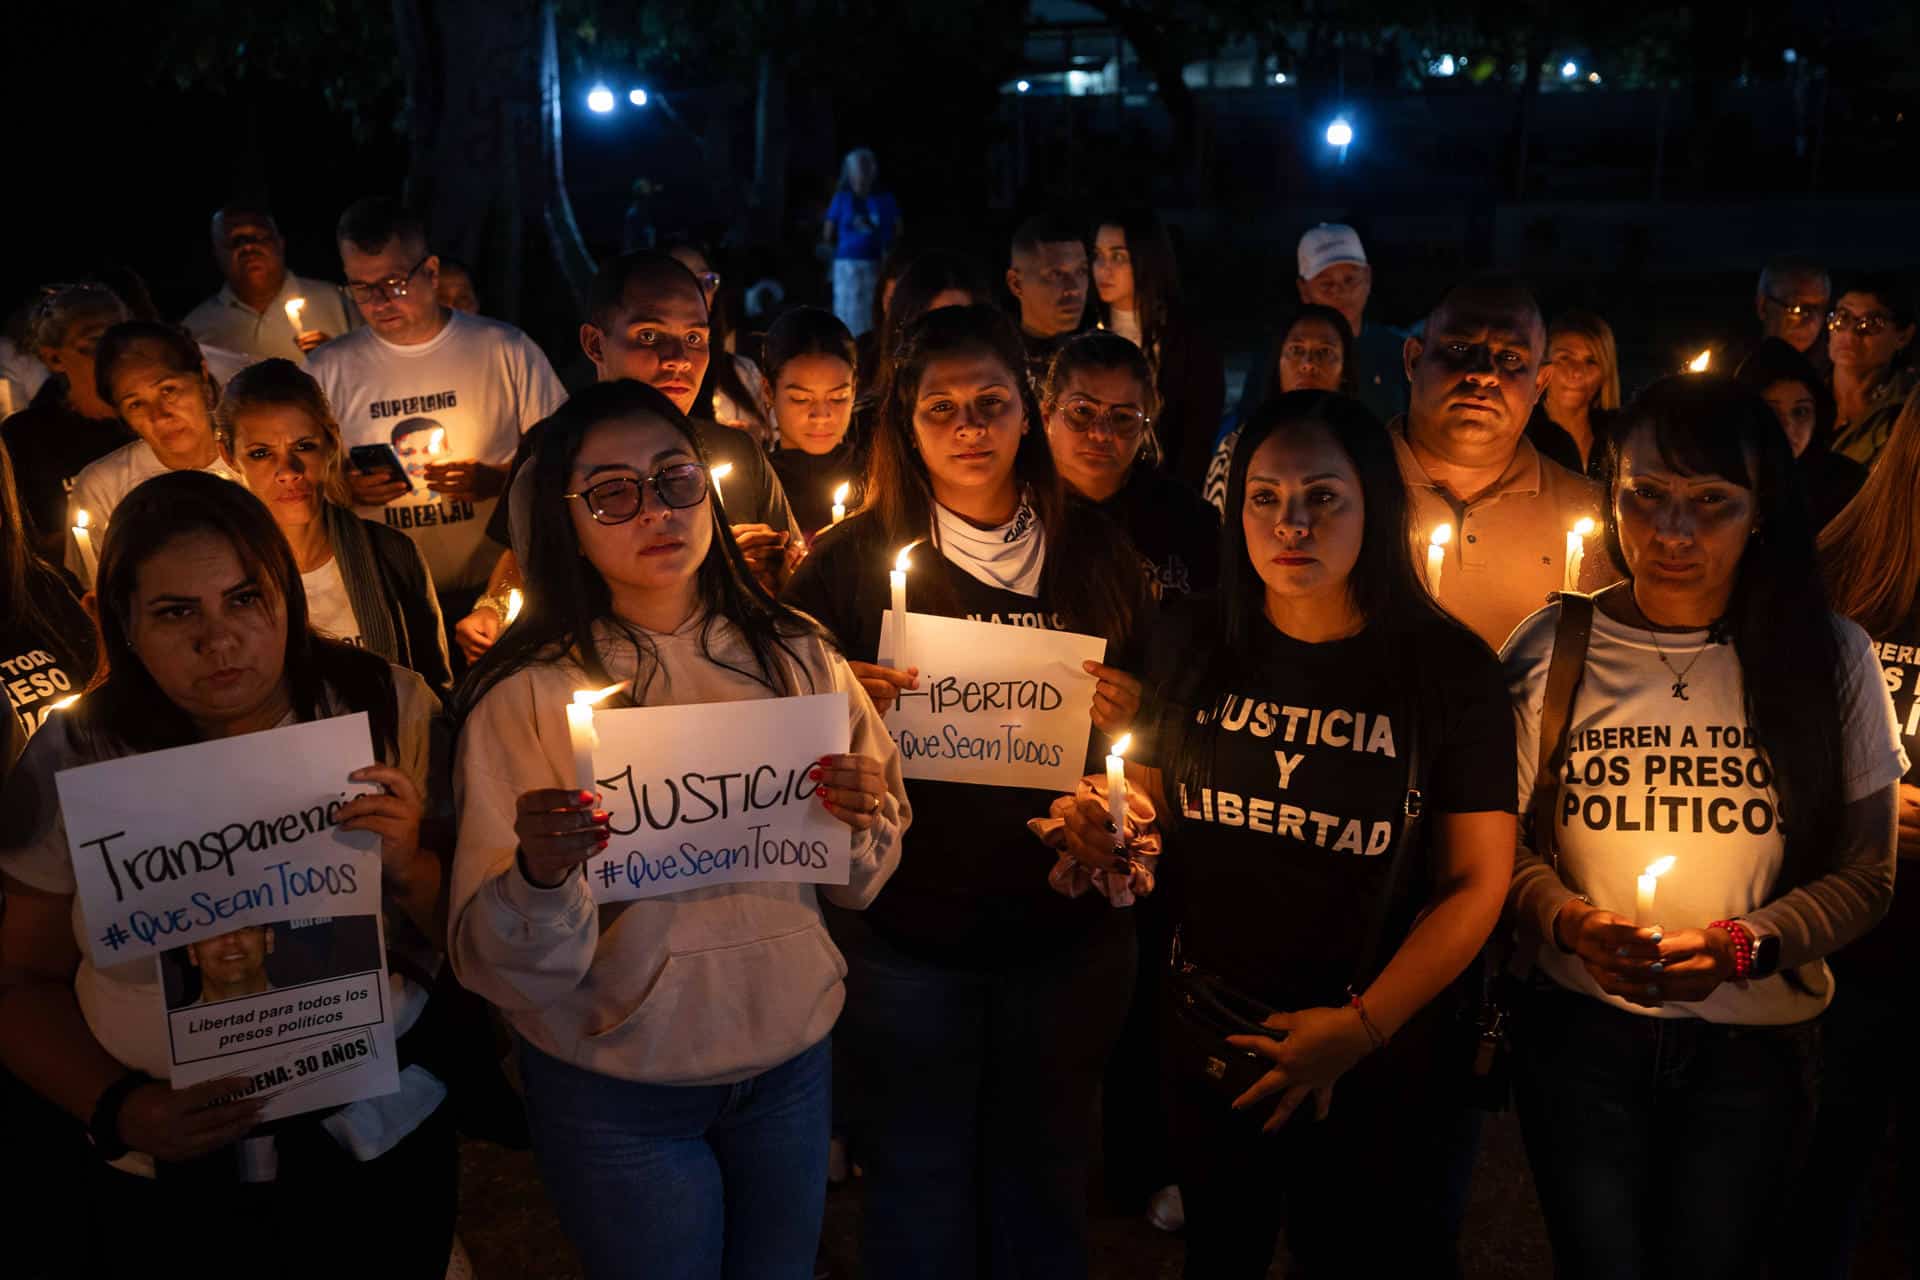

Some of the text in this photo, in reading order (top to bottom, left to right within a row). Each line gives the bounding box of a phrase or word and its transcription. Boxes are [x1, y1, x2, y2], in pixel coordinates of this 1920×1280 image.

[1196, 693, 1398, 759] USTICIA
[1569, 725, 1671, 752] LIBEREN
[1680, 726, 1698, 748] A
[1273, 750, 1305, 789] Y
[1565, 755, 1772, 788] LOS PRESO
[1180, 782, 1393, 857] LIBERTAD
[79, 792, 368, 902] Transparenc
[188, 989, 369, 1034] Libertad para todos los
[219, 1027, 273, 1048] presos
[294, 1054, 319, 1077] 30
[322, 1038, 369, 1069] AÑOS
